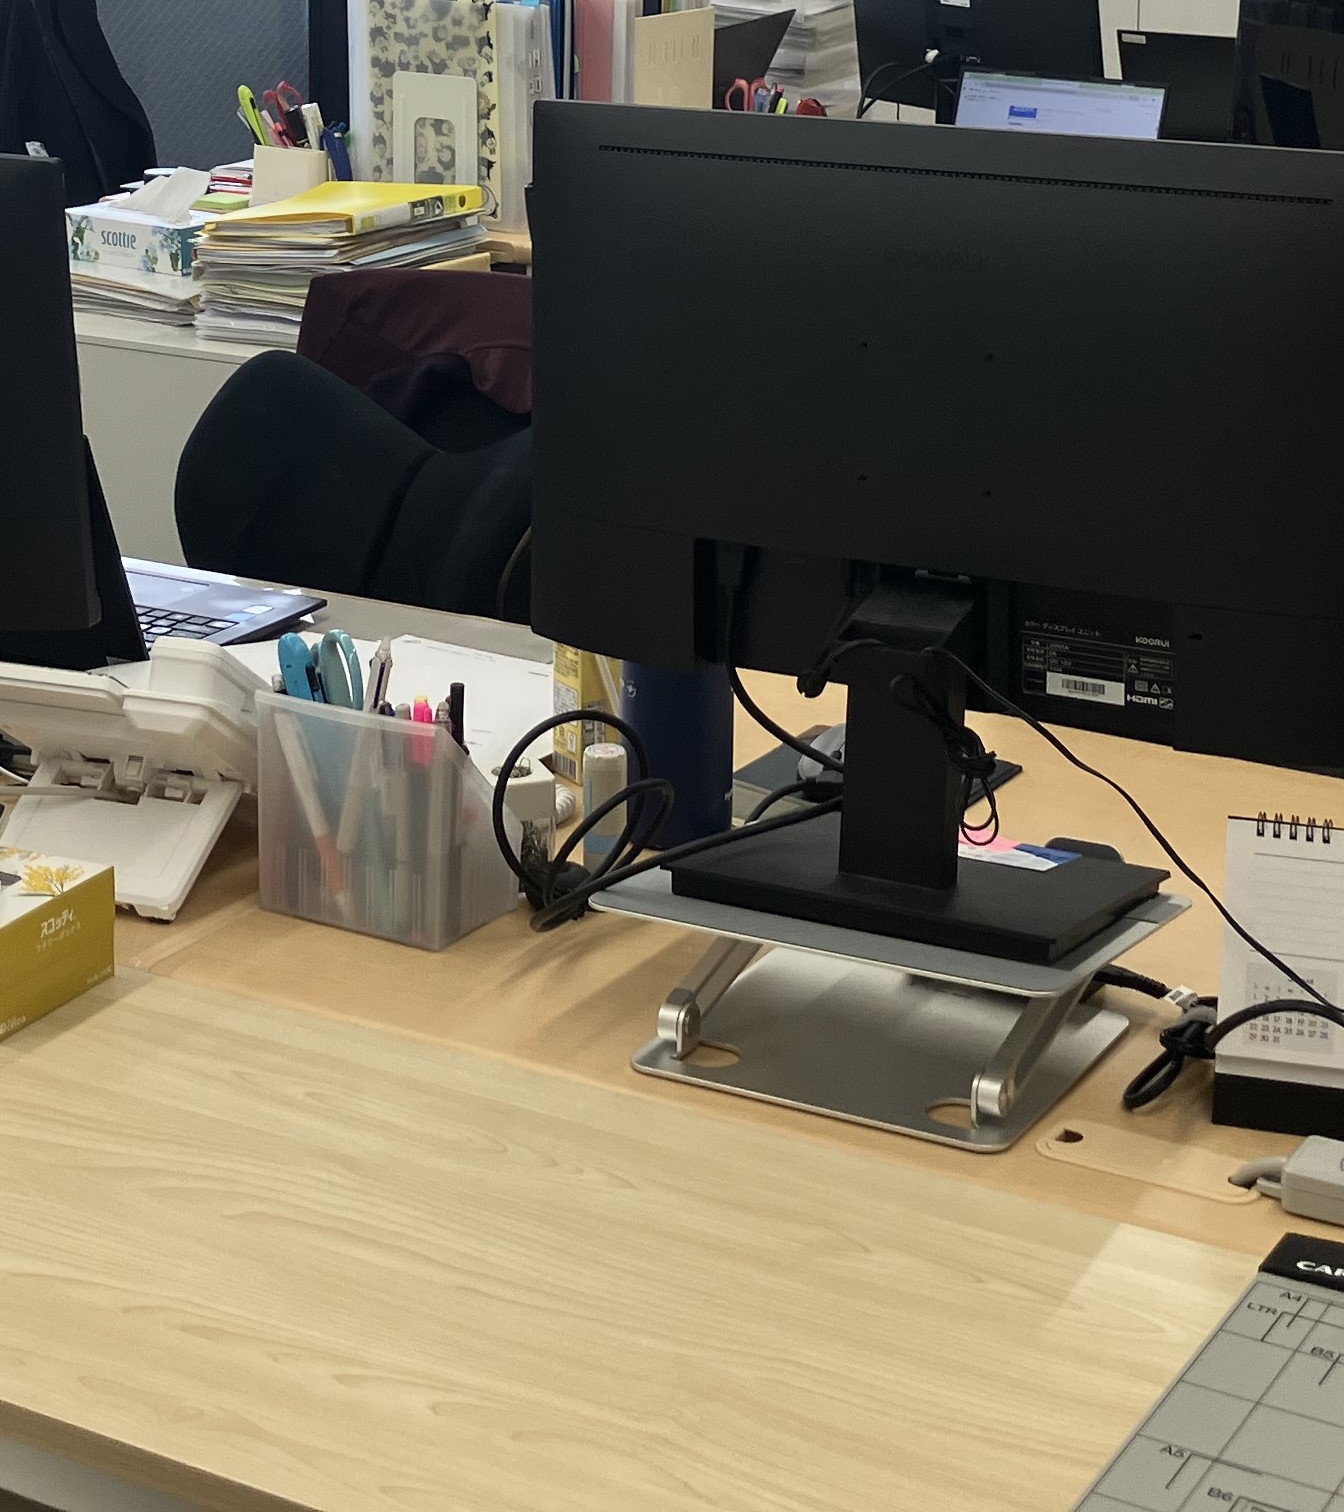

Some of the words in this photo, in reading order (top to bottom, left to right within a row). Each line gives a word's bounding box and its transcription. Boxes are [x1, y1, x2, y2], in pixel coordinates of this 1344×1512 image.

[101, 230, 137, 249] scottie
[41, 908, 74, 938] スコッティ
[1280, 1290, 1303, 1303] A4
[1247, 1302, 1278, 1316] LTR
[1310, 1346, 1335, 1359] B5
[1160, 1445, 1184, 1459] A5
[1208, 1487, 1233, 1502] B6
